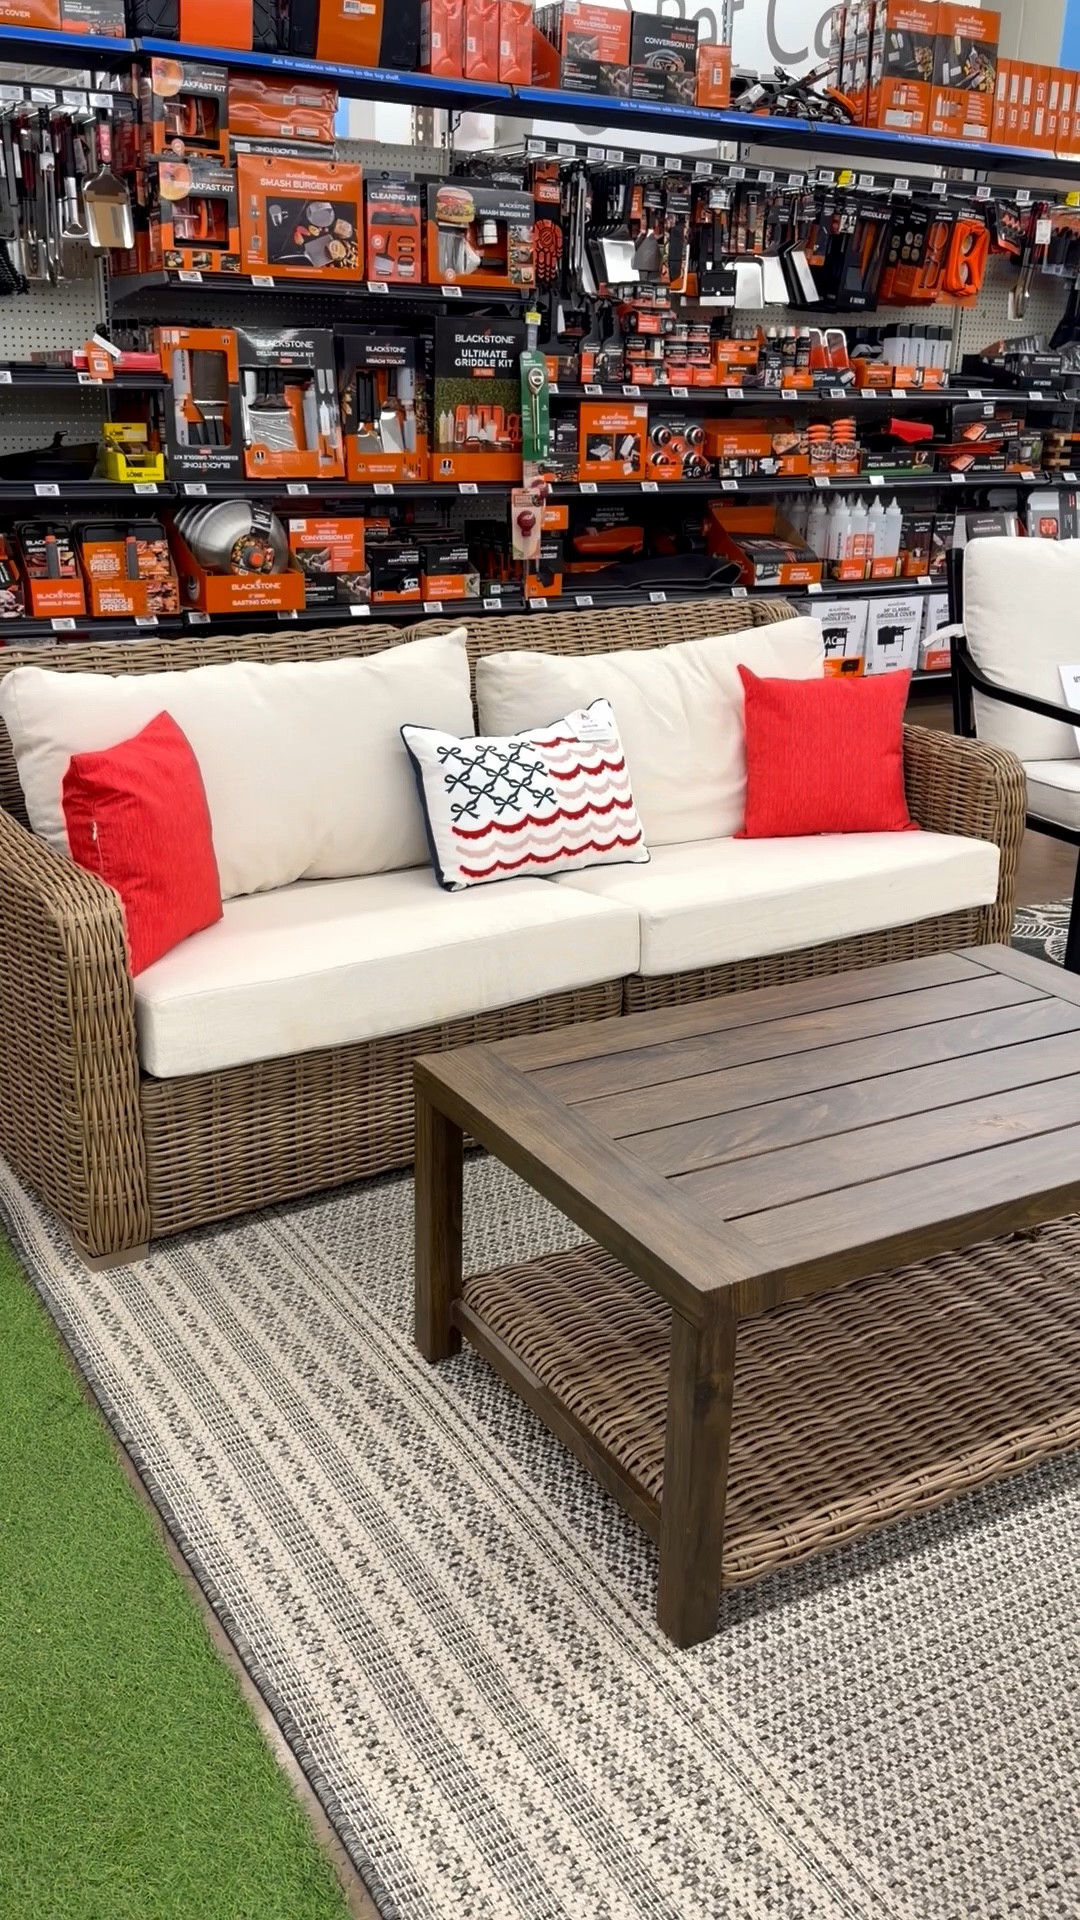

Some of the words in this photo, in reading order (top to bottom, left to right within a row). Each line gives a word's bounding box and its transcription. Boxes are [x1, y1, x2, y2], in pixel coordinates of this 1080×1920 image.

[5, 9, 30, 18] COVER
[574, 20, 611, 30] CONVERSION
[644, 36, 684, 48] CONVERSION
[685, 42, 695, 50] KIT
[214, 84, 226, 93] KIT
[222, 184, 235, 193] KIT
[260, 177, 292, 188] SMASH
[292, 180, 328, 191] BURGER
[329, 182, 344, 192] KIT
[370, 192, 406, 201] CLEANING
[406, 194, 418, 202] KIT
[480, 208, 501, 216] SMASH
[501, 210, 520, 218] BURGER
[861, 210, 881, 220] GRIDDLE
[256, 339, 315, 349] BLACKSTONE
[455, 334, 516, 344] BLACKSTONE
[366, 345, 406, 354] BLACKSTONE
[462, 349, 508, 359] ULTIMATE
[455, 358, 496, 368] GRIDDLE
[498, 358, 514, 368] KIT
[300, 534, 342, 542] CONVERSION
[232, 582, 282, 591] BLACKSTONE
[37, 591, 80, 600] BLACKSTONE
[260, 598, 282, 606] COVER
[100, 604, 134, 612] PRESS
